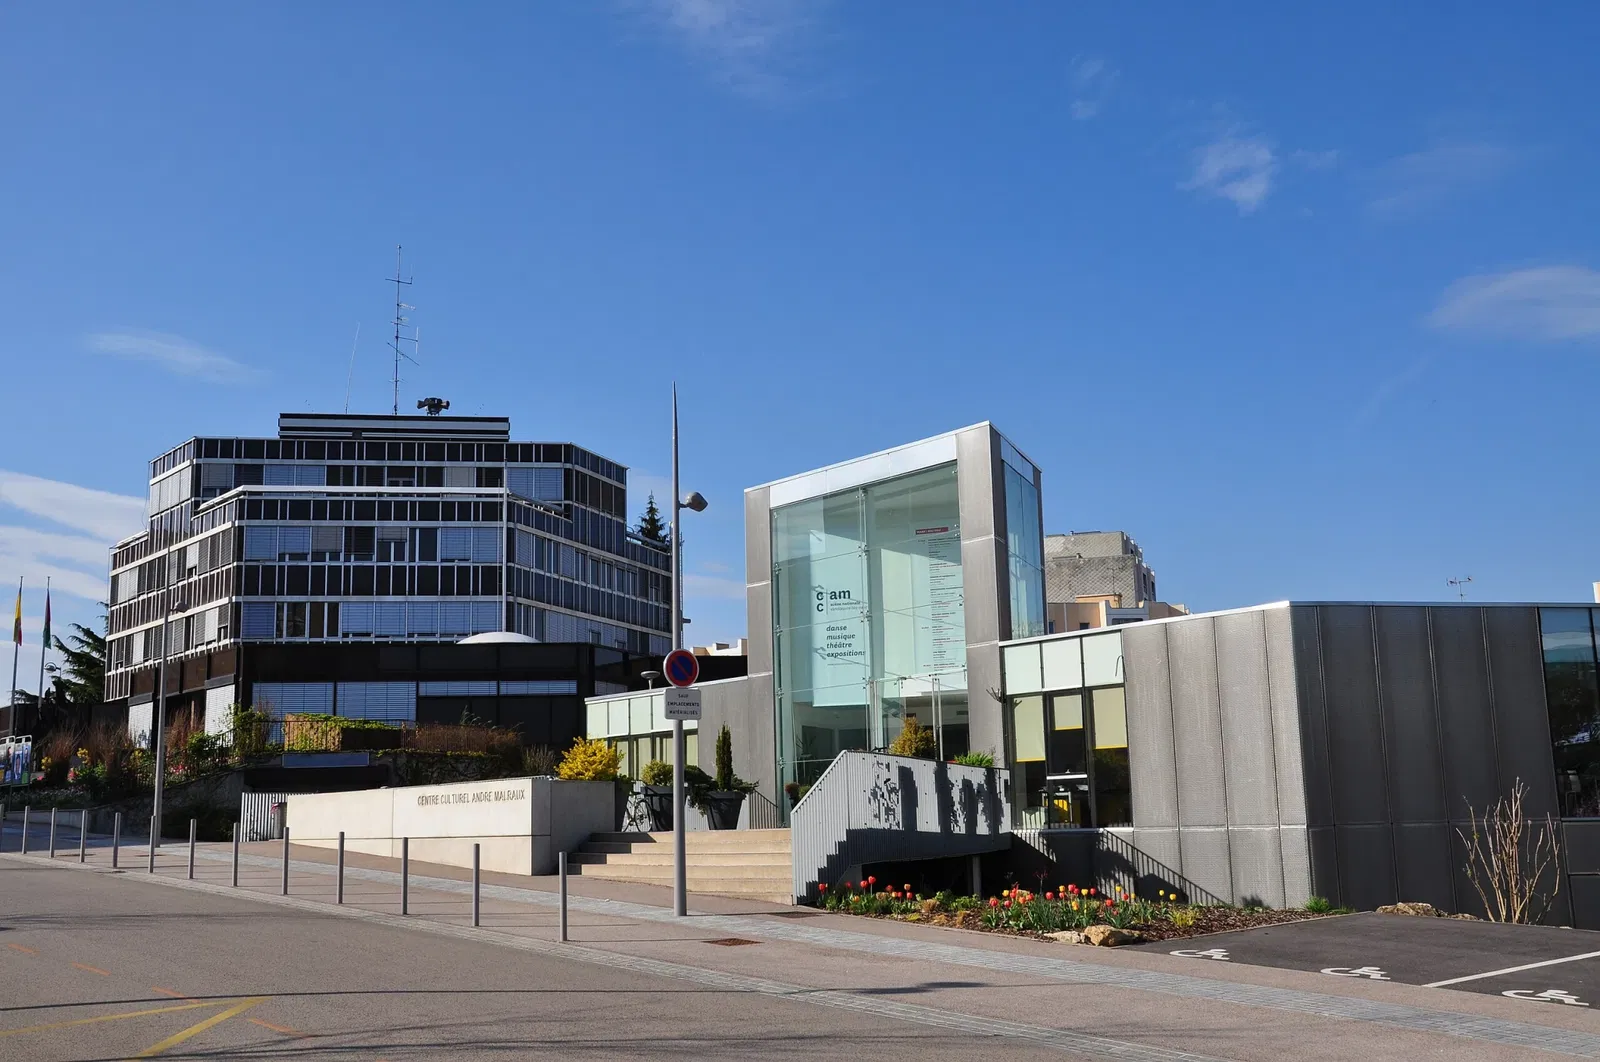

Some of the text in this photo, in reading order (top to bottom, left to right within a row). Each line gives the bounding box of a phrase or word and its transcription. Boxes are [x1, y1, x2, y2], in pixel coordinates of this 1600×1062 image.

[830, 590, 850, 600] am
[826, 633, 856, 641] musique
[826, 650, 866, 658] expositions
[417, 789, 525, 806] CENTRE CULTUREL ANDRE MALRAUX
